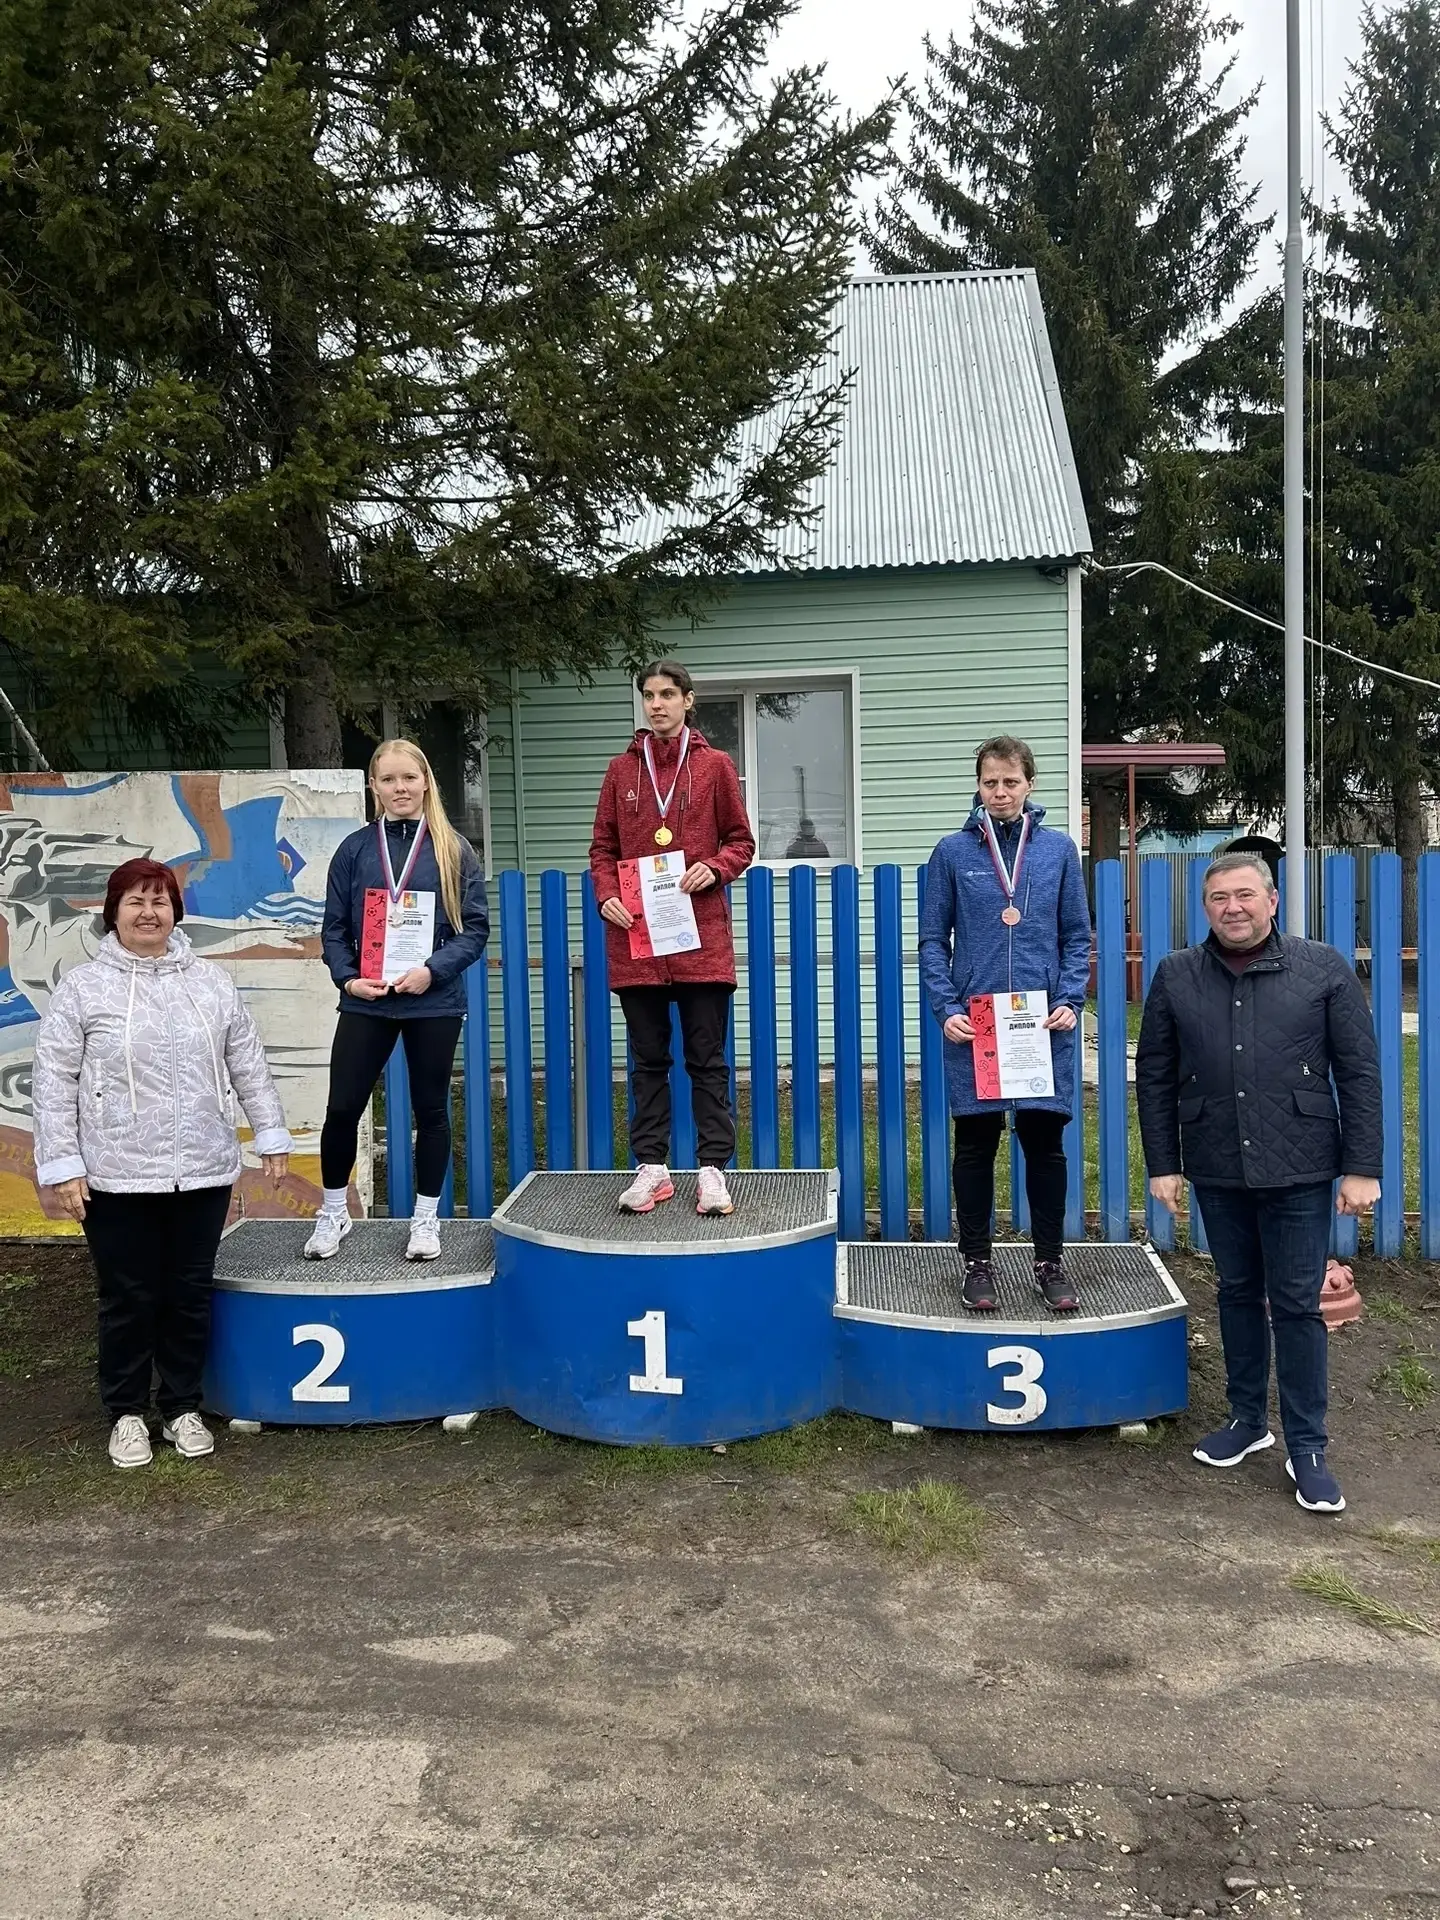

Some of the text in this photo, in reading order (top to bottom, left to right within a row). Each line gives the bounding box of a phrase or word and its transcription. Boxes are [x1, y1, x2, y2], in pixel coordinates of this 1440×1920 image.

[653, 882, 676, 892] ДИПЛОМ
[1009, 1022, 1036, 1031] ДИПЛОМ
[292, 1323, 350, 1402] 2
[627, 1310, 683, 1395] 1
[987, 1346, 1047, 1425] 3
